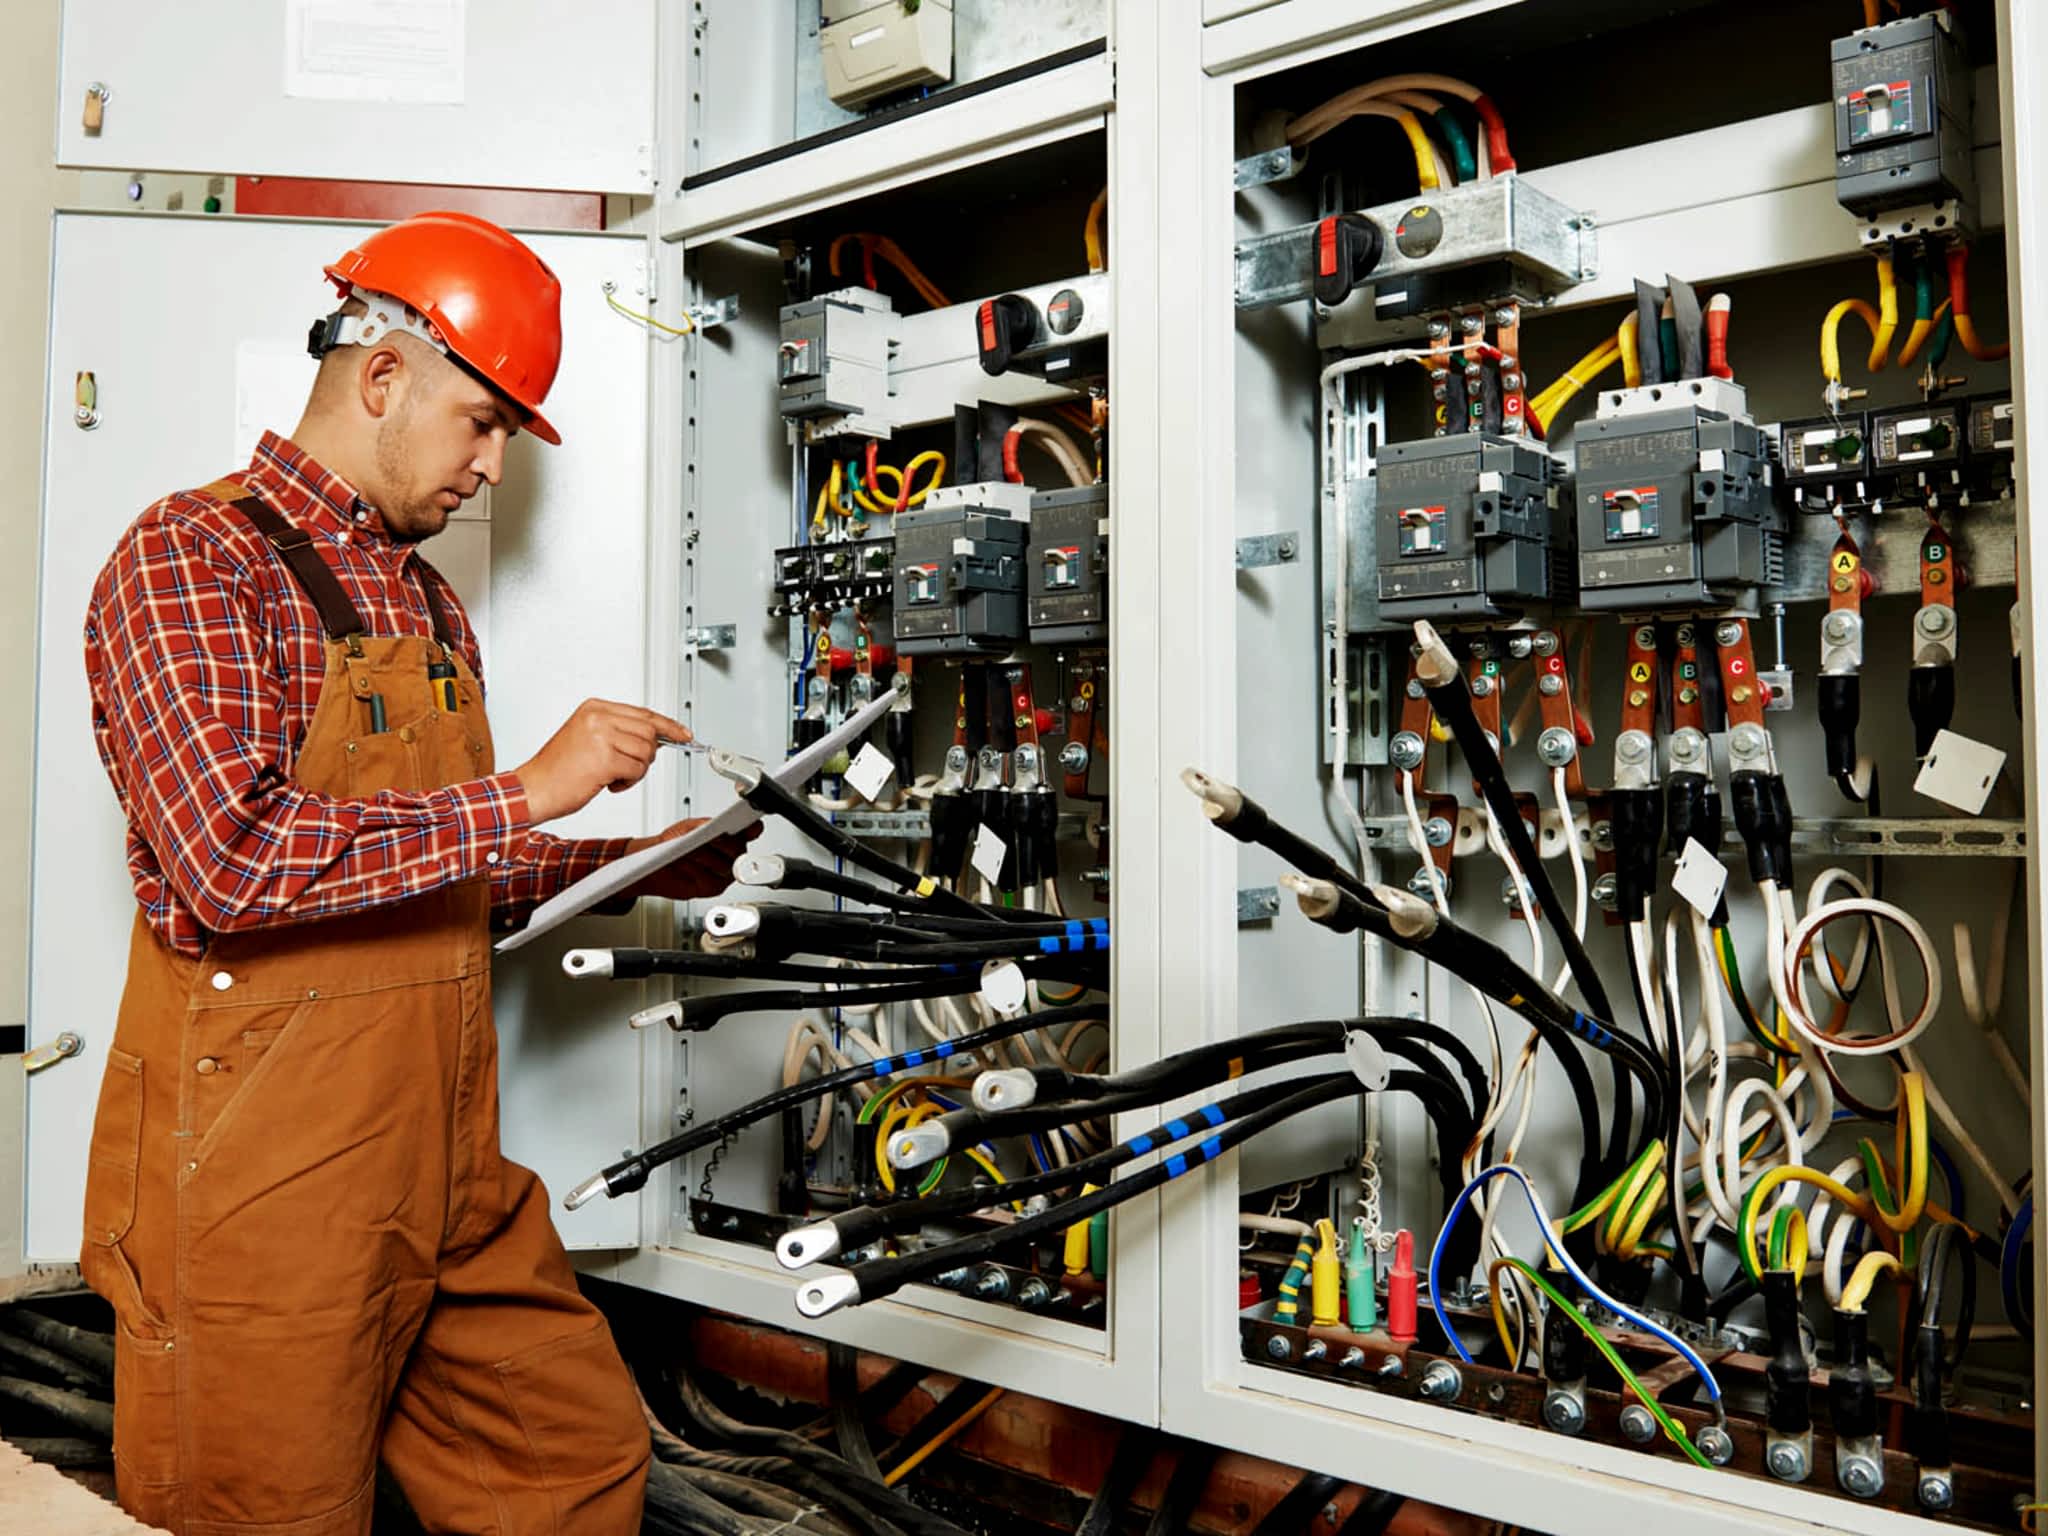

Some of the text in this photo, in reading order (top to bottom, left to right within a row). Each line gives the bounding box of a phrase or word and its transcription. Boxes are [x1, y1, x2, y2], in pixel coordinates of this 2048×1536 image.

[1507, 399, 1518, 412] C
[1929, 546, 1943, 559] B
[1838, 555, 1851, 569] A
[1485, 662, 1496, 673] B
[1550, 658, 1561, 672] C
[1635, 665, 1647, 677] A
[1684, 665, 1695, 677] B
[1731, 661, 1743, 674] C
[1083, 683, 1091, 694] A
[1018, 696, 1026, 707] C
